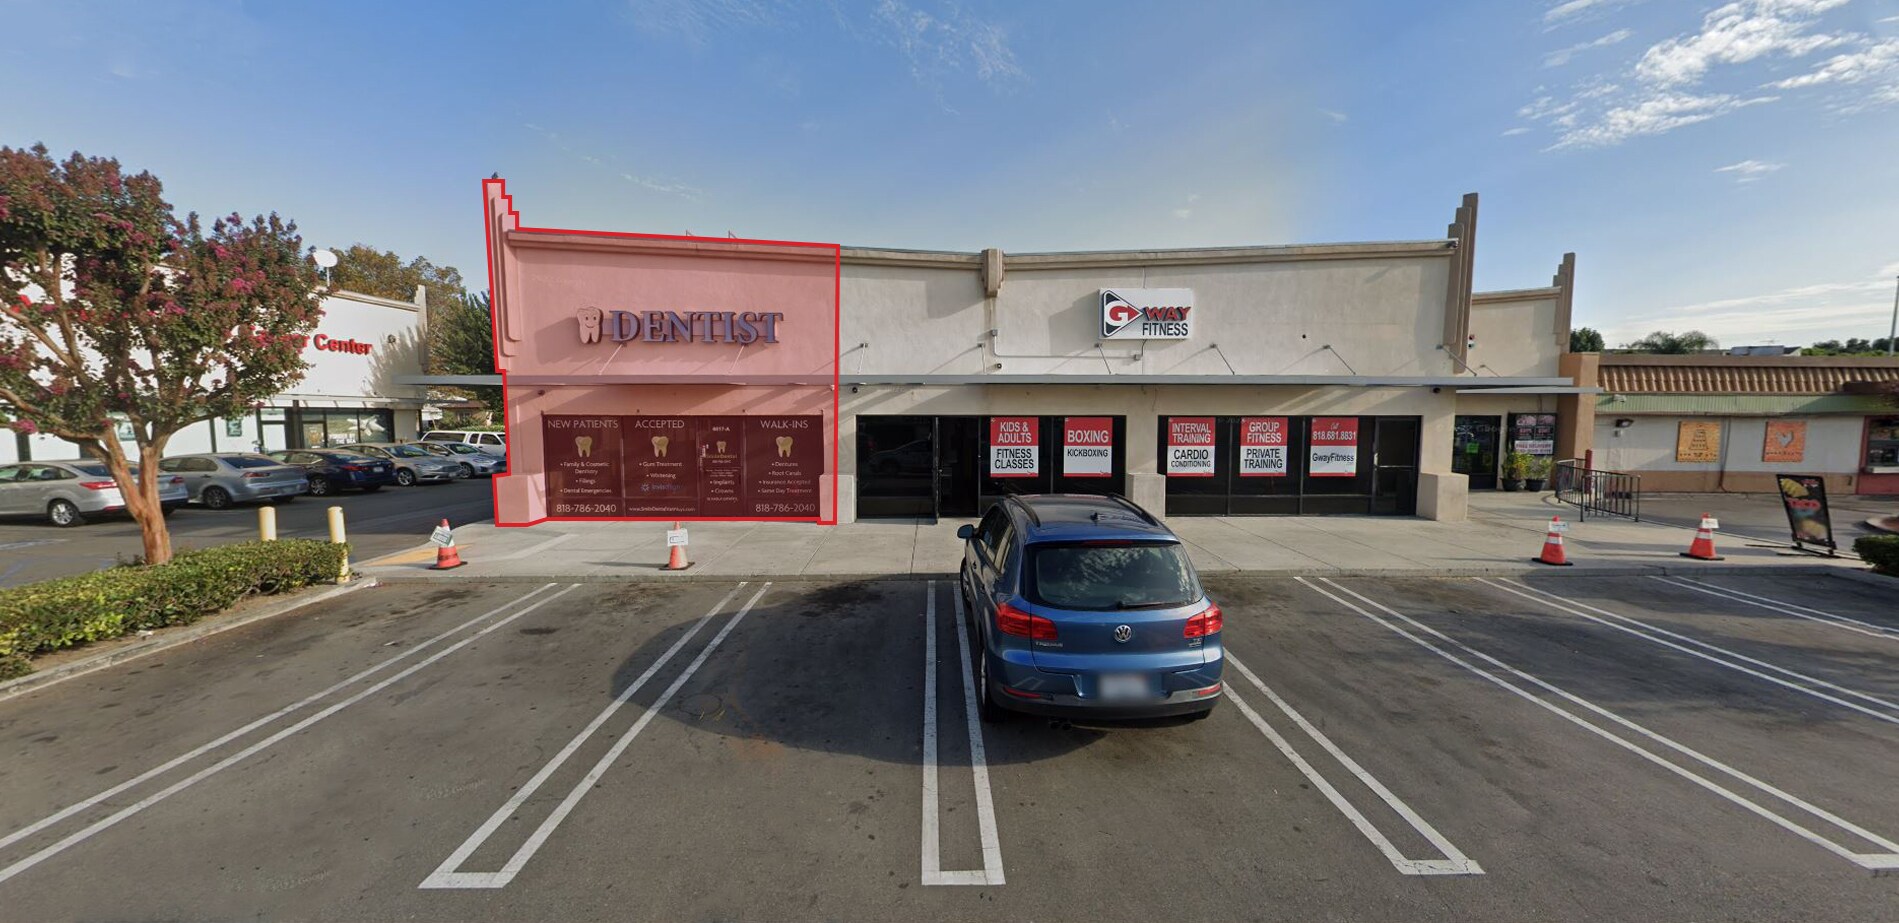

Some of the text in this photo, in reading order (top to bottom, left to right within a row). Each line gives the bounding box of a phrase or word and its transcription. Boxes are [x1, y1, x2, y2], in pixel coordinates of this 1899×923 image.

[609, 310, 784, 344] DENTIST
[1142, 322, 1189, 336] FITNESS
[313, 333, 373, 356] Center
[547, 419, 619, 429] NEW PATIENTS
[634, 419, 685, 429] ACCEPTED
[760, 419, 809, 429] WALK-INS
[1000, 421, 1029, 432] KIDS &
[1172, 423, 1211, 433] INTERVAL
[1248, 421, 1280, 432] GROUP
[997, 433, 1032, 443] ADULTS
[1067, 430, 1109, 443] BOXING
[1172, 433, 1211, 443] TRAINING
[1246, 432, 1282, 443] FITNESS
[1312, 430, 1357, 441] 818.681.8831
[996, 448, 1032, 459] FITNESS
[1067, 448, 1109, 457] KICKBOXING
[1173, 449, 1209, 460] CARDIO
[1246, 448, 1281, 459] PRIVATE
[1312, 452, 1355, 464] GwayFitness
[994, 459, 1034, 469] CLASSES
[1171, 460, 1211, 468] CONDITIONING
[1244, 459, 1283, 469] TRAINING
[556, 504, 617, 512] 818-786-2040
[755, 503, 816, 513] 818-786-2040
